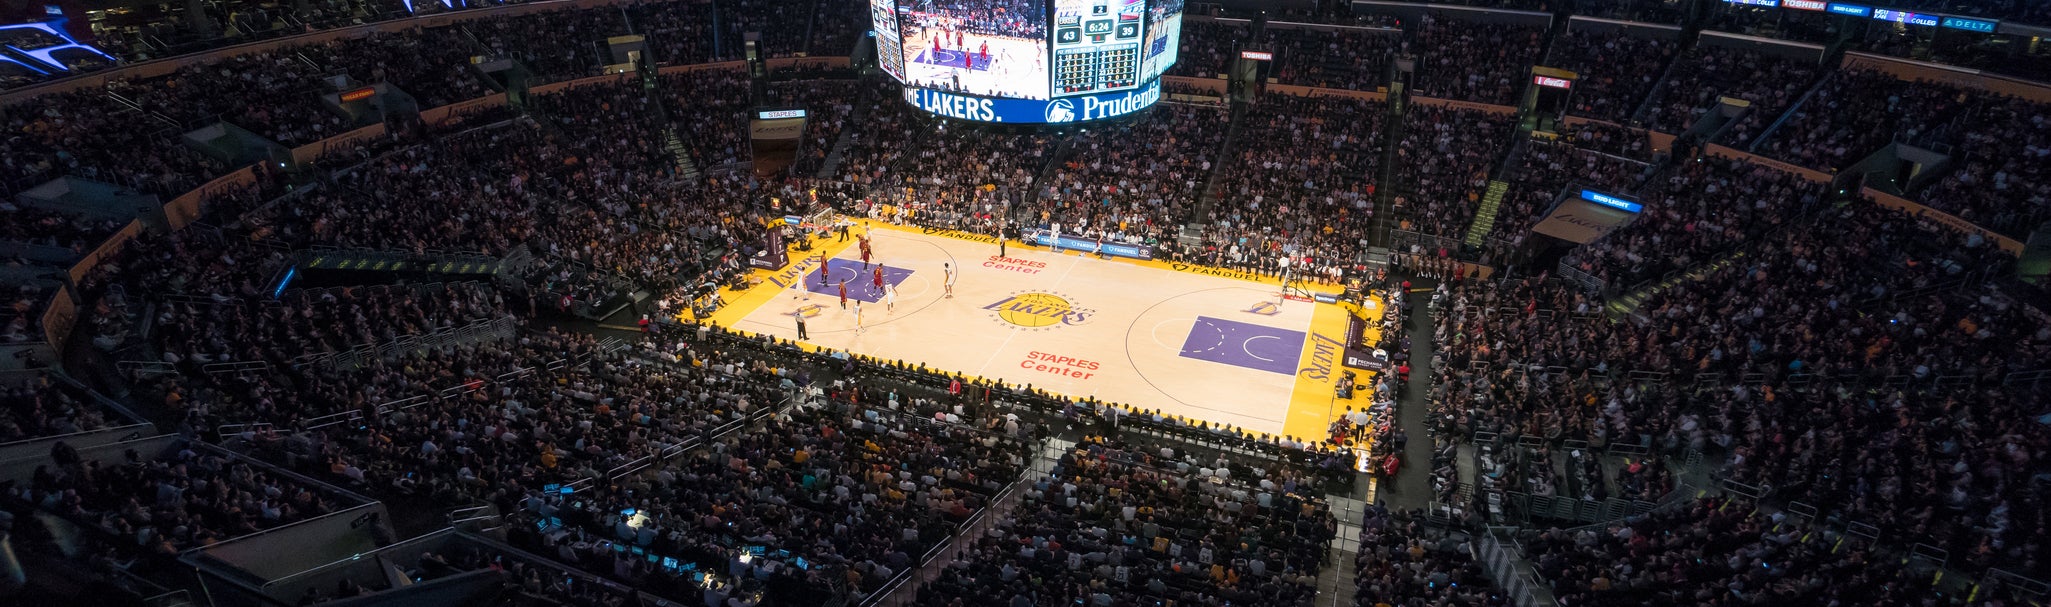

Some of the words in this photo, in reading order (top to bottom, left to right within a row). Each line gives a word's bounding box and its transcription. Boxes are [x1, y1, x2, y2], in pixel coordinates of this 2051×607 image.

[1784, 0, 1826, 10] TOSHIBA
[1089, 23, 1110, 32] 6:24
[1121, 26, 1134, 36] 39
[1955, 20, 1992, 31] DELTA
[1062, 31, 1076, 41] 43
[1242, 52, 1273, 60] TOSHIBA
[924, 89, 1002, 122] LAKERS.
[768, 111, 797, 119] STAPLES
[1593, 194, 1609, 204] BUD
[1608, 198, 1629, 208] LIGHT
[938, 230, 998, 244] FANDUEL
[1114, 247, 1137, 256] FANDUEL
[988, 254, 1048, 269] STAPLES
[982, 262, 1040, 275] Center
[1191, 266, 1262, 283] FANDUEL
[980, 296, 1097, 326] LAKERS
[1027, 350, 1101, 371] STAPLES
[1300, 330, 1344, 384] LAKERS
[1357, 359, 1383, 367] PECHANGA
[1020, 359, 1095, 380] Center
